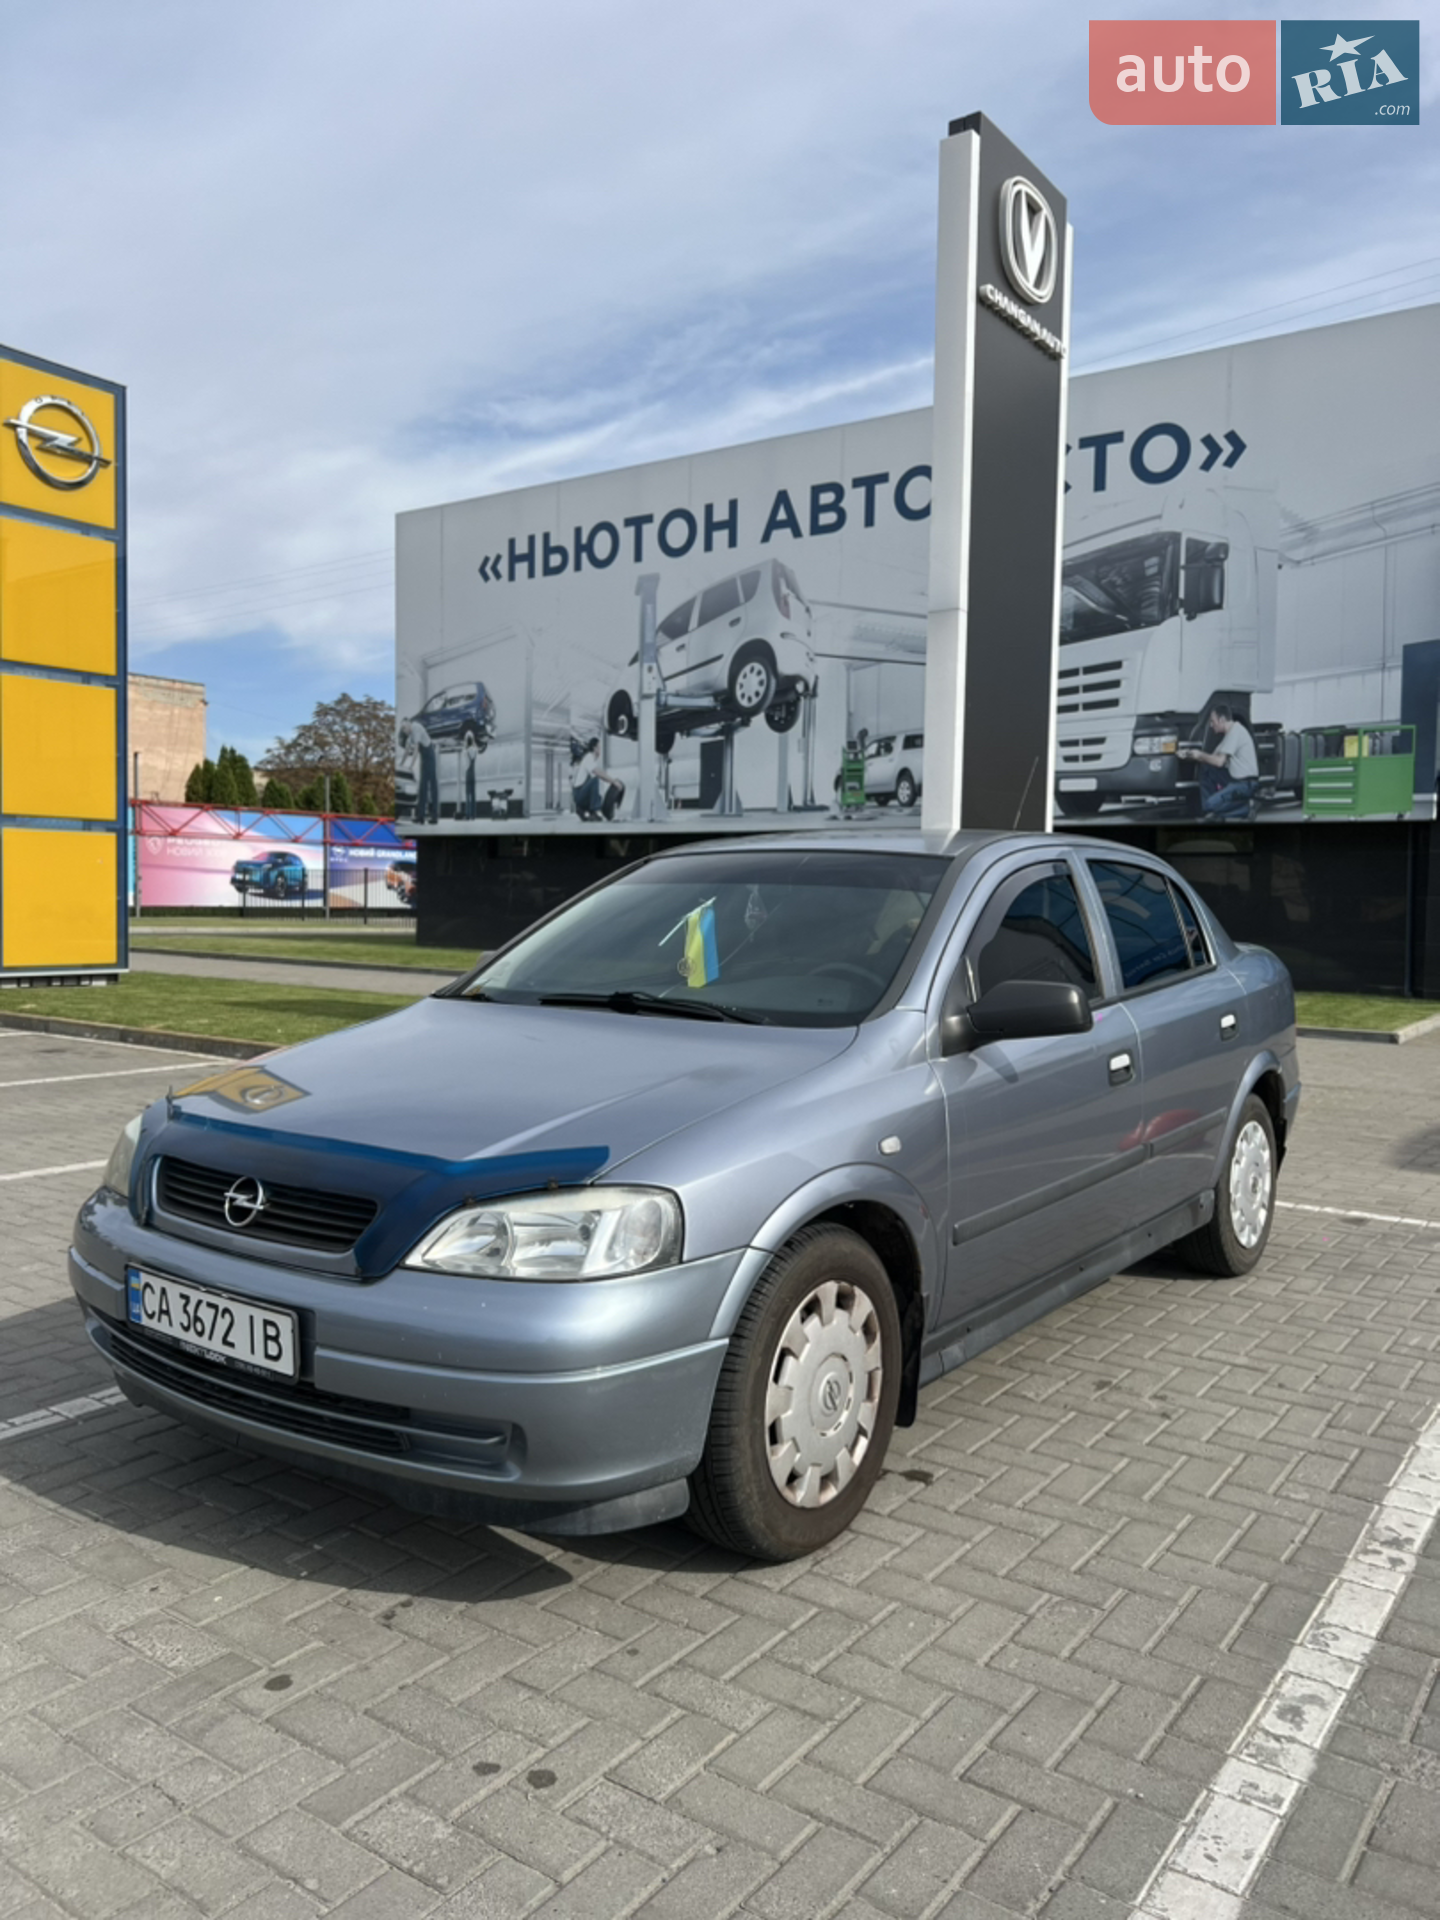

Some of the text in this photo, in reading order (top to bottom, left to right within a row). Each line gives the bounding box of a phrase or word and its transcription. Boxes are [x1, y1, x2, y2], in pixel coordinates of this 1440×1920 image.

[478, 422, 1248, 583] «НЬЮТОН АВТО ТО»
[142, 1281, 284, 1363] CA 3672 IB
